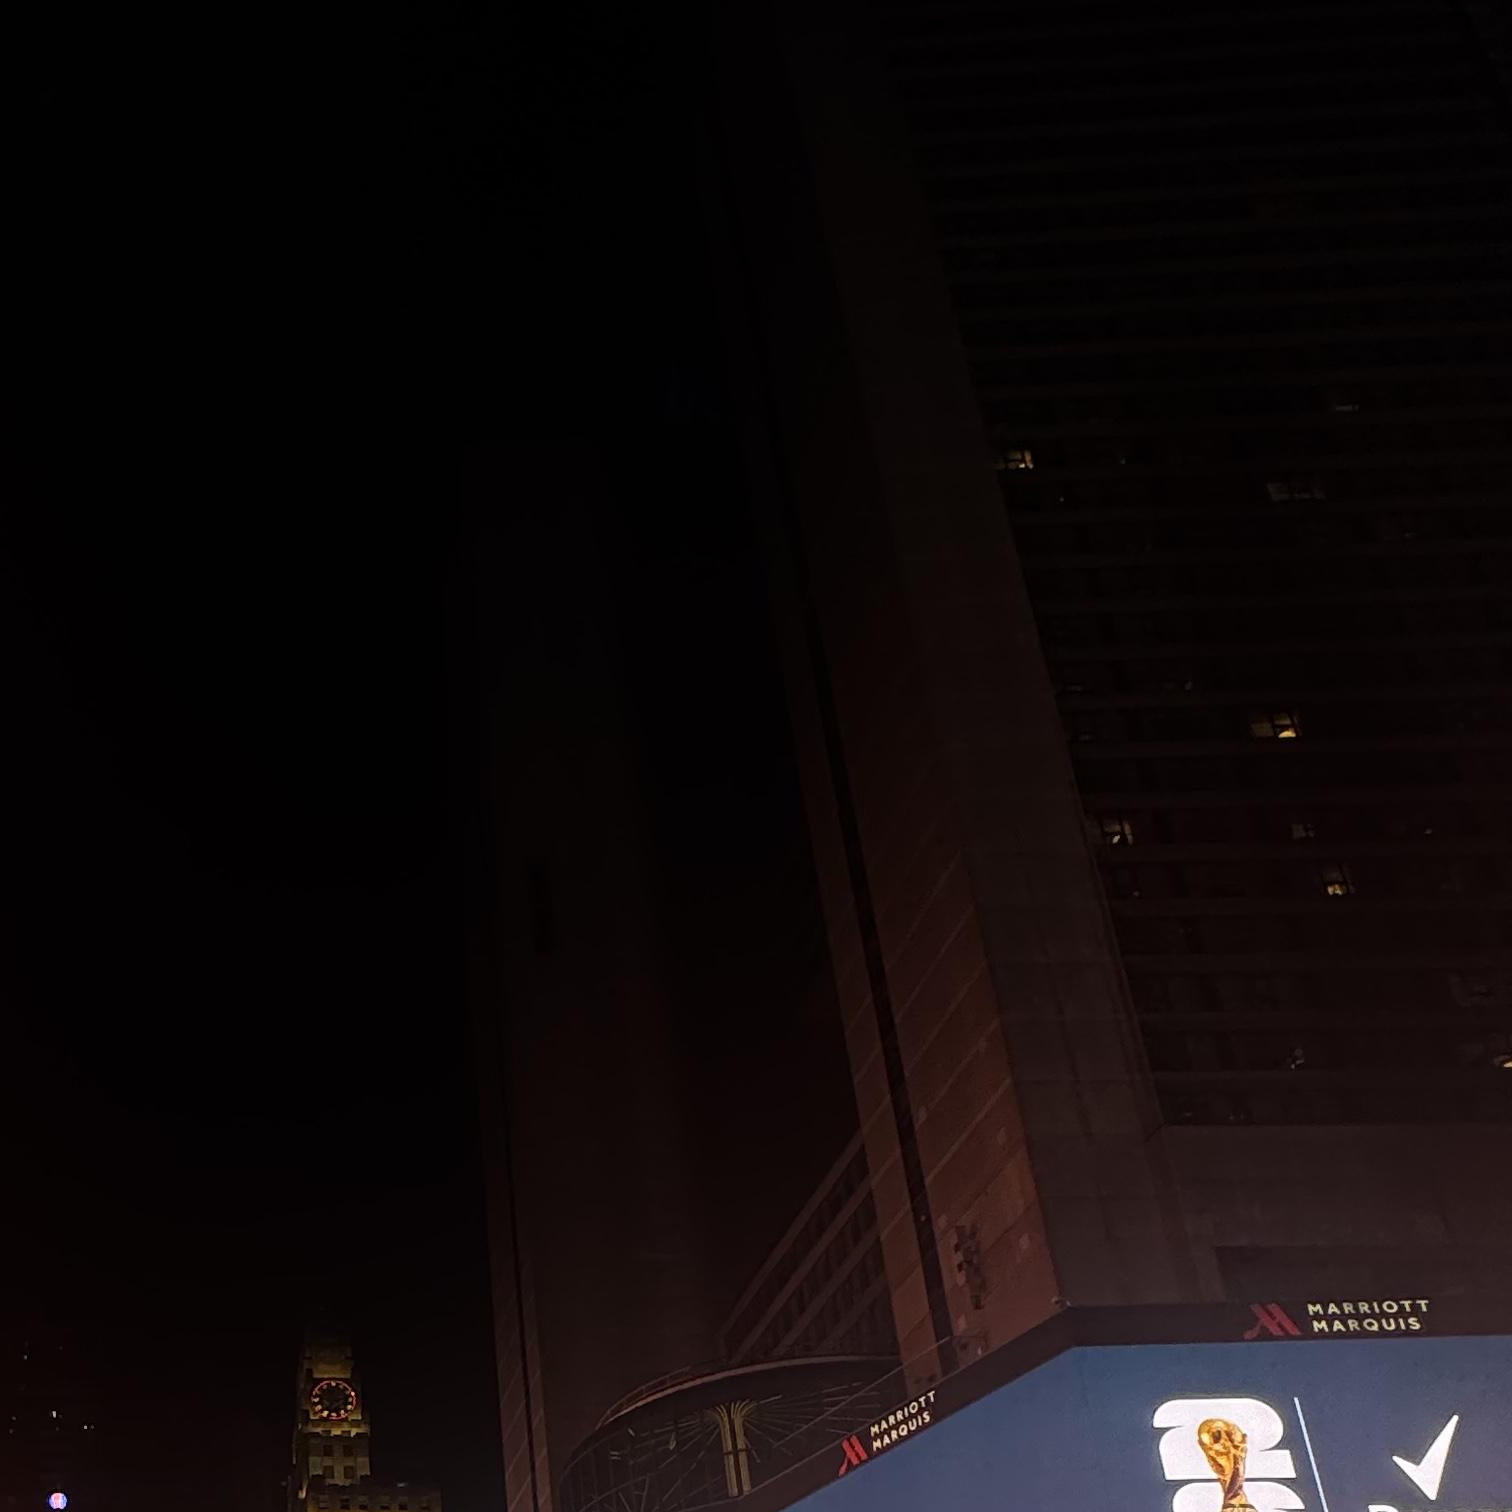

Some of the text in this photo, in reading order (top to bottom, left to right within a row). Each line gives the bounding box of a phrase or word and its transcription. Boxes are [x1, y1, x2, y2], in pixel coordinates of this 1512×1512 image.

[1307, 1300, 1430, 1317] MARRIOTT
[1312, 1317, 1422, 1333] MARQUIS
[869, 1390, 936, 1437] MARRIOTT
[872, 1410, 931, 1452] MARQUIS
